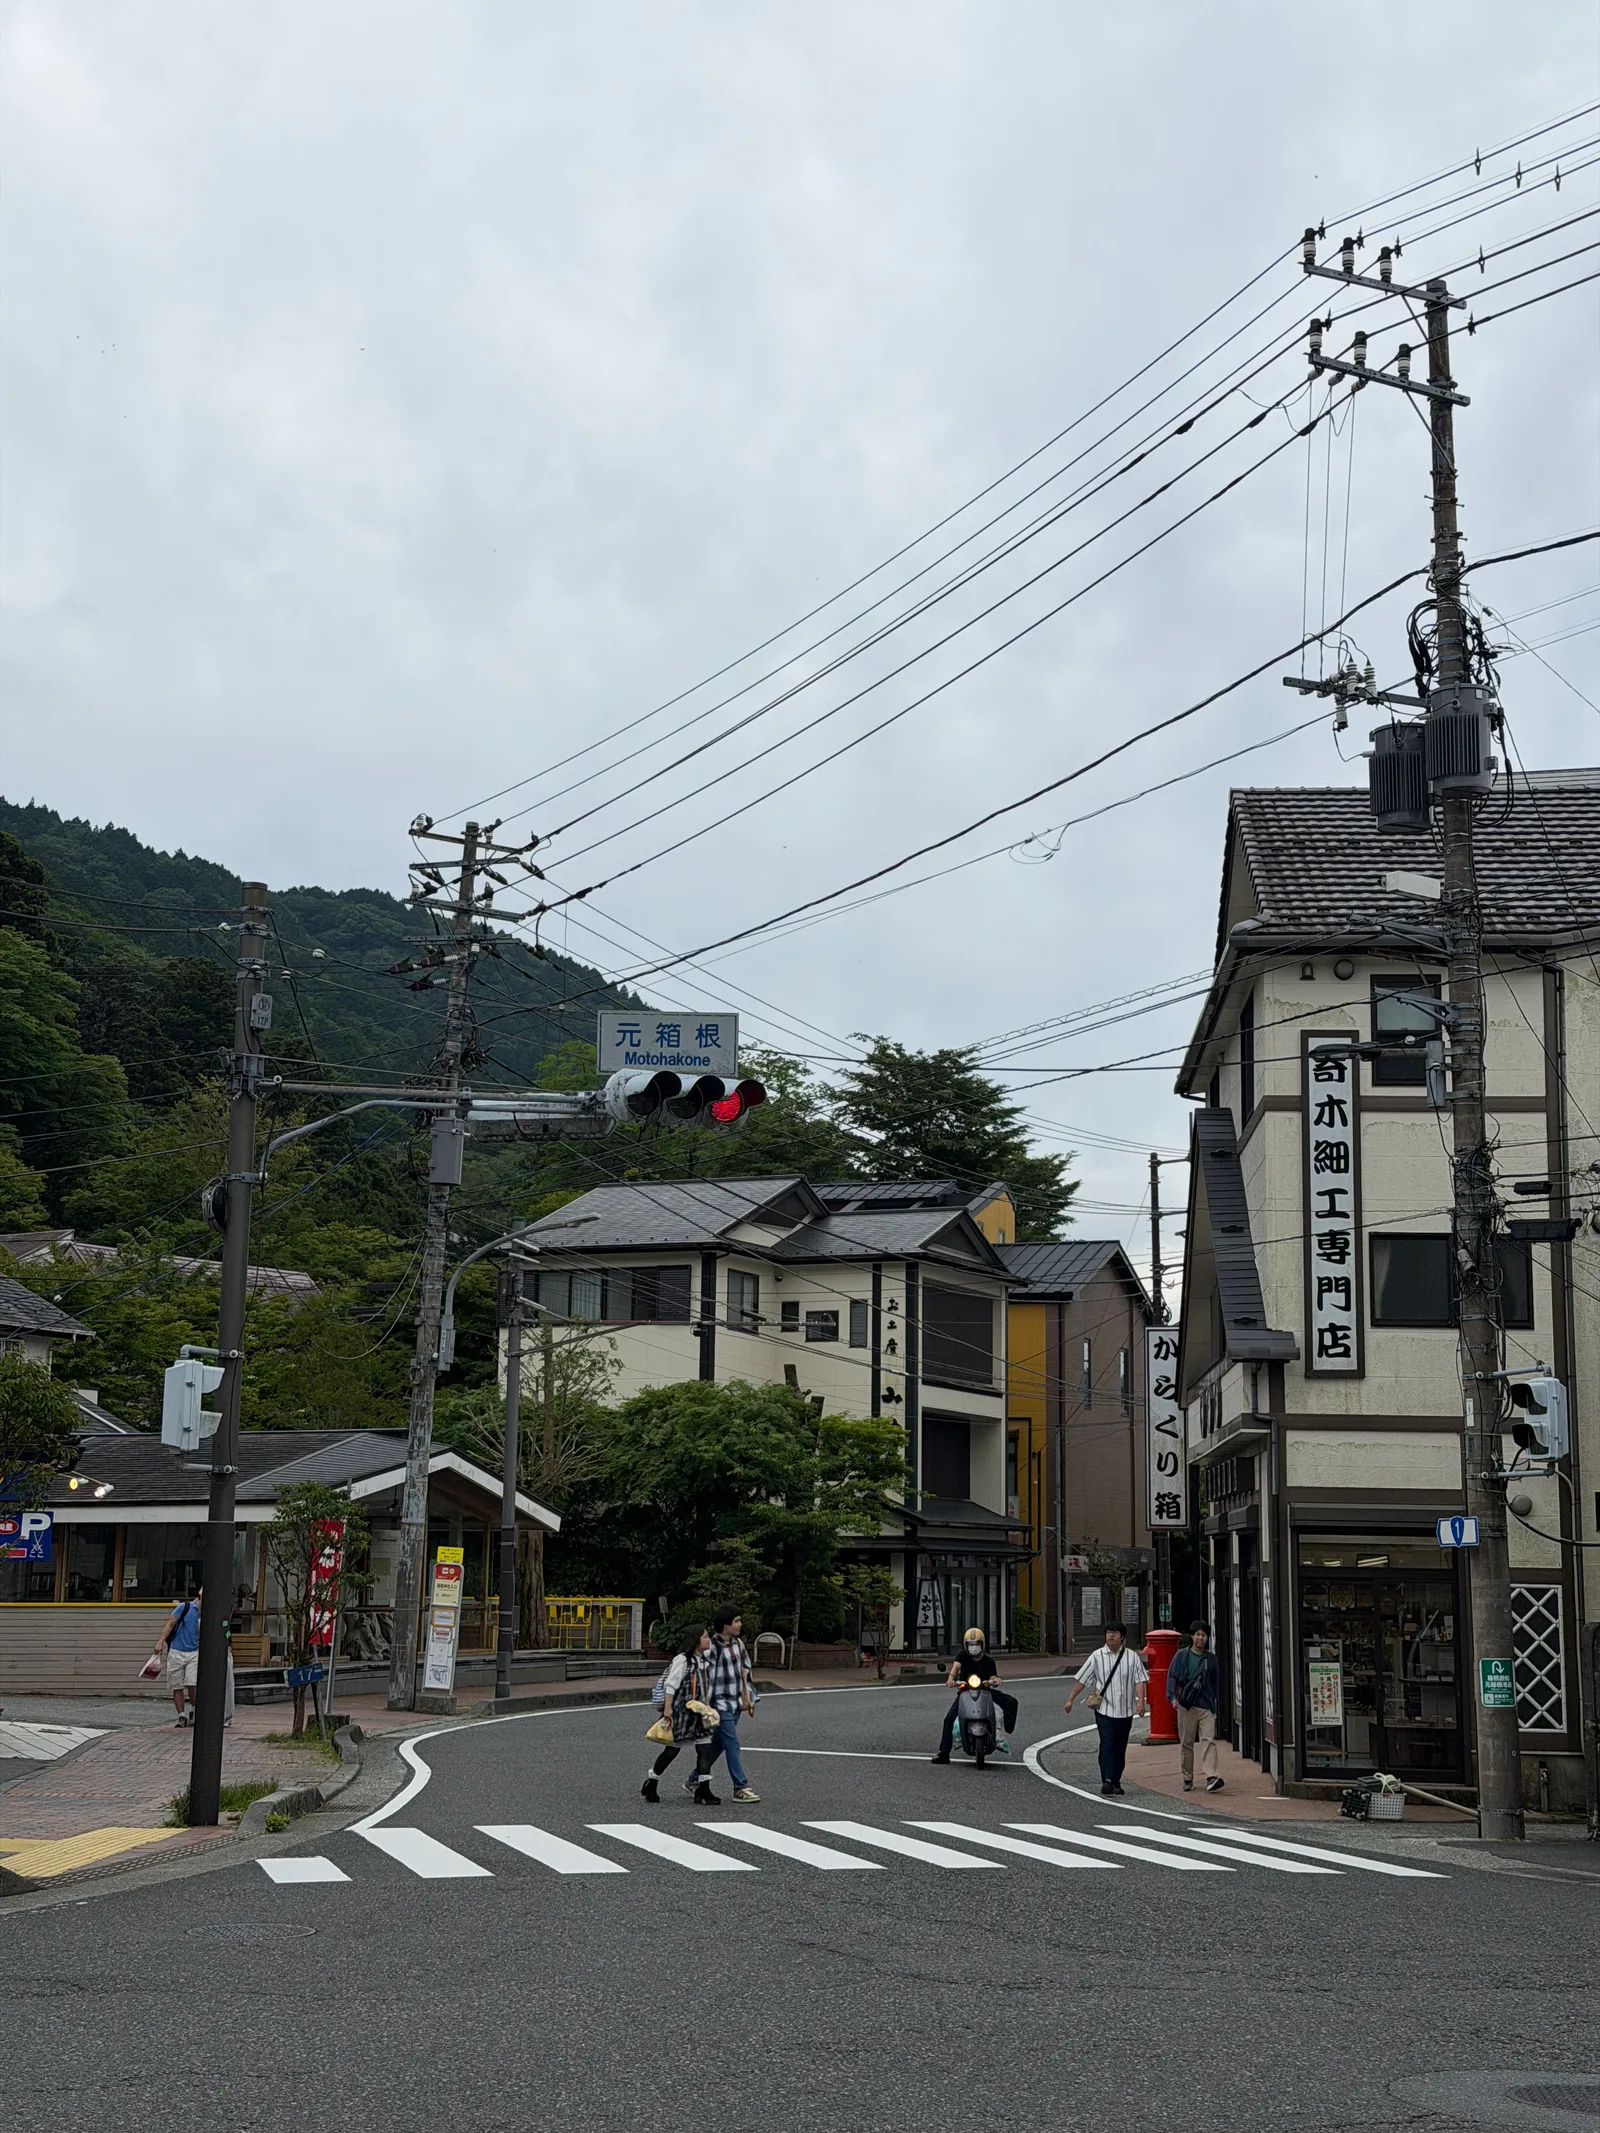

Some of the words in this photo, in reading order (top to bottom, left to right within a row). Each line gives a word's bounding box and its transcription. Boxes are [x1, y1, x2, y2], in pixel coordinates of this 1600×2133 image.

[615, 1022, 722, 1049] 元箱根
[624, 1051, 711, 1067] Motohakone
[1312, 1058, 1352, 1359] 寄木細工専門店
[1153, 1335, 1182, 1521] からくり箱
[20, 1512, 52, 1541] P
[1454, 1520, 1460, 1539] 1
[298, 1668, 312, 1681] 17
